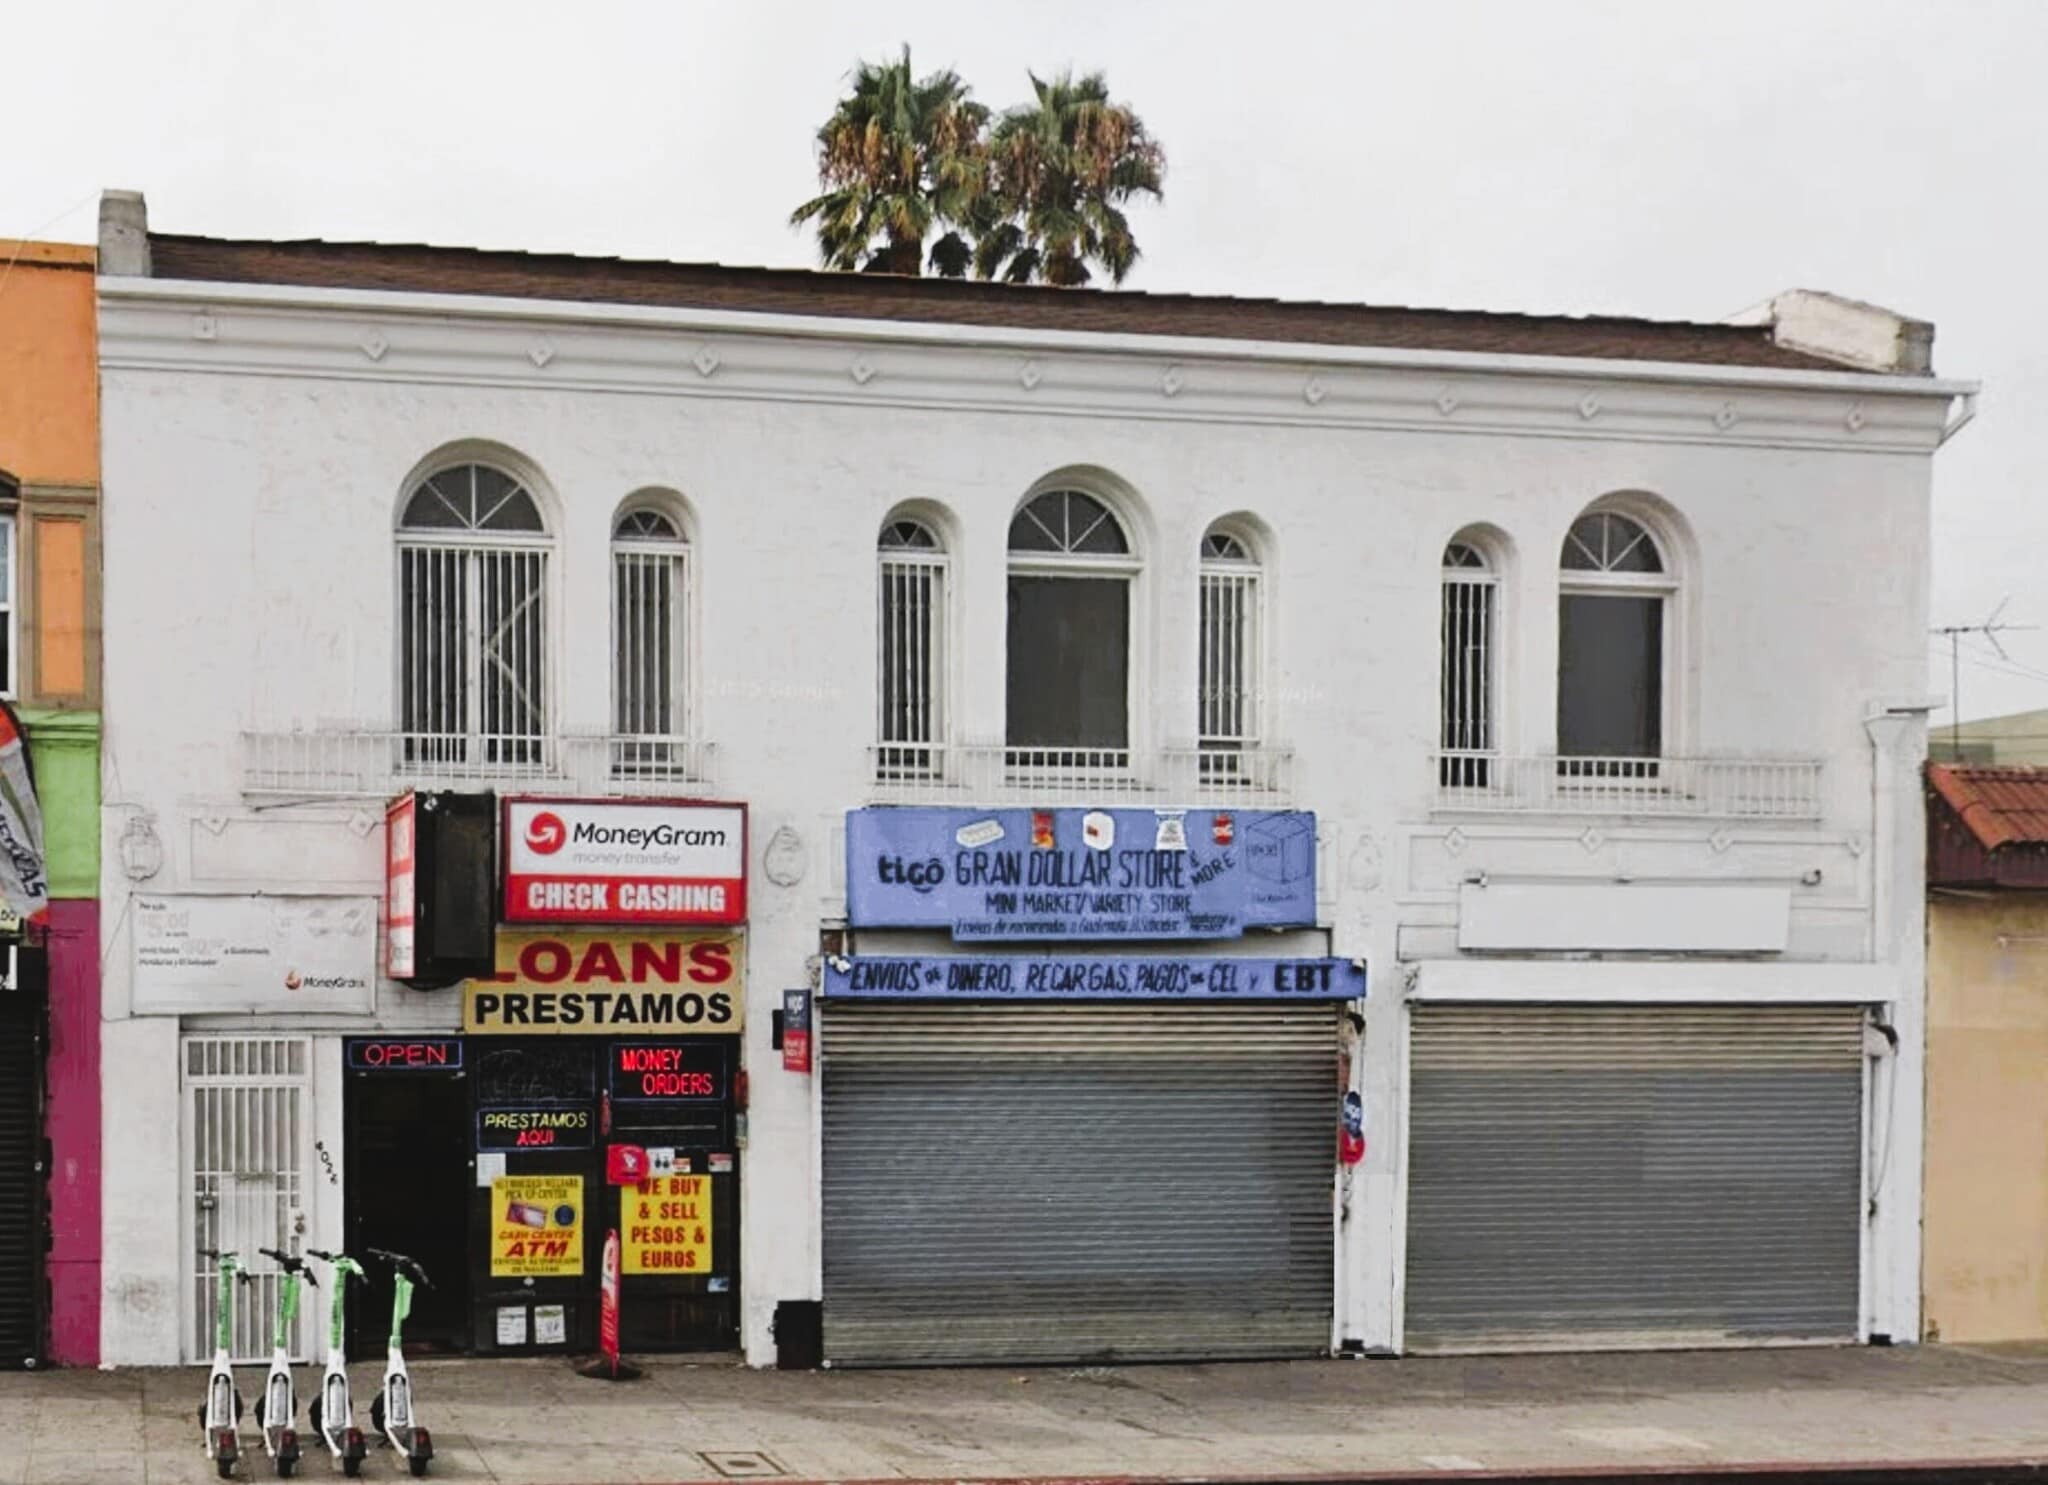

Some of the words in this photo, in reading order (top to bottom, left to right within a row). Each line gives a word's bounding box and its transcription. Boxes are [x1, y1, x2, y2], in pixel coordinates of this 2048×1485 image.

[572, 823, 726, 850] MoneyGram
[573, 853, 622, 865] money
[624, 852, 681, 864] transfer
[956, 851, 1022, 886] GRAN
[1028, 850, 1111, 887] DOLLAR
[1119, 850, 1187, 888] STORE
[1190, 850, 1236, 886] MORE
[528, 882, 609, 911] CHECK
[619, 884, 726, 912] CASHING
[986, 893, 1017, 914] MINI
[1153, 893, 1192, 914] STORE
[850, 962, 922, 991] ENVIOS
[1134, 963, 1190, 993] PAGOS
[1208, 962, 1239, 992] CEL
[1274, 964, 1336, 992] EBT
[475, 992, 732, 1025] PRESTAMOS
[365, 1044, 447, 1066] OPEN
[621, 1049, 683, 1071] MONEY
[643, 1073, 713, 1095] ORDERS
[485, 1112, 588, 1130] PRESTAMOS
[516, 1130, 555, 1146] AQUI
[636, 1178, 661, 1196] WE
[670, 1178, 703, 1195] BUY
[639, 1202, 649, 1219] &
[660, 1202, 699, 1220] SELL
[631, 1226, 685, 1243] PESOS
[694, 1226, 705, 1244] &
[505, 1240, 569, 1257] ATM
[641, 1250, 696, 1268] EUROS
